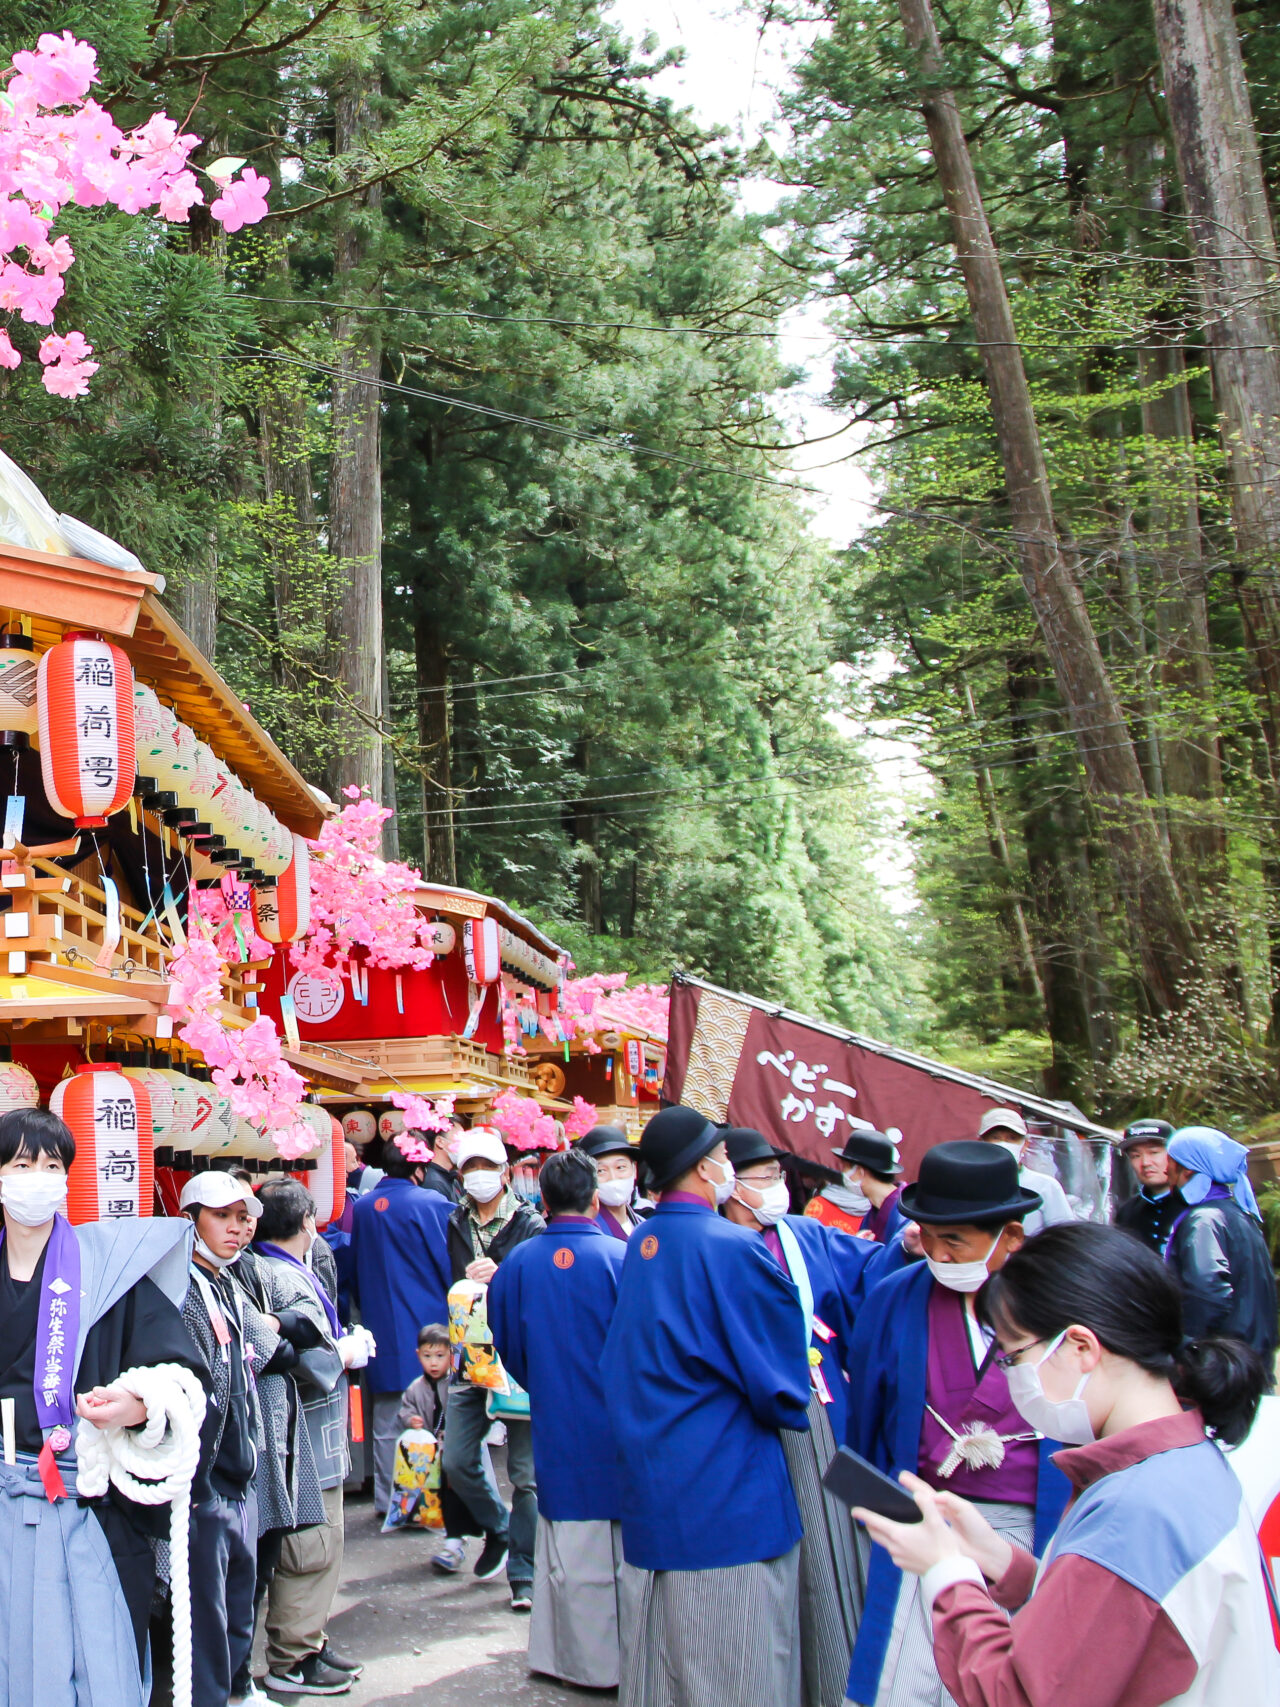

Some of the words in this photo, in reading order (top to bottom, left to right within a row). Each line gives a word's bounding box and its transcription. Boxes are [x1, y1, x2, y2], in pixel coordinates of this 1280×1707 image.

[42, 1298, 68, 1408] 弥生祭当番町
